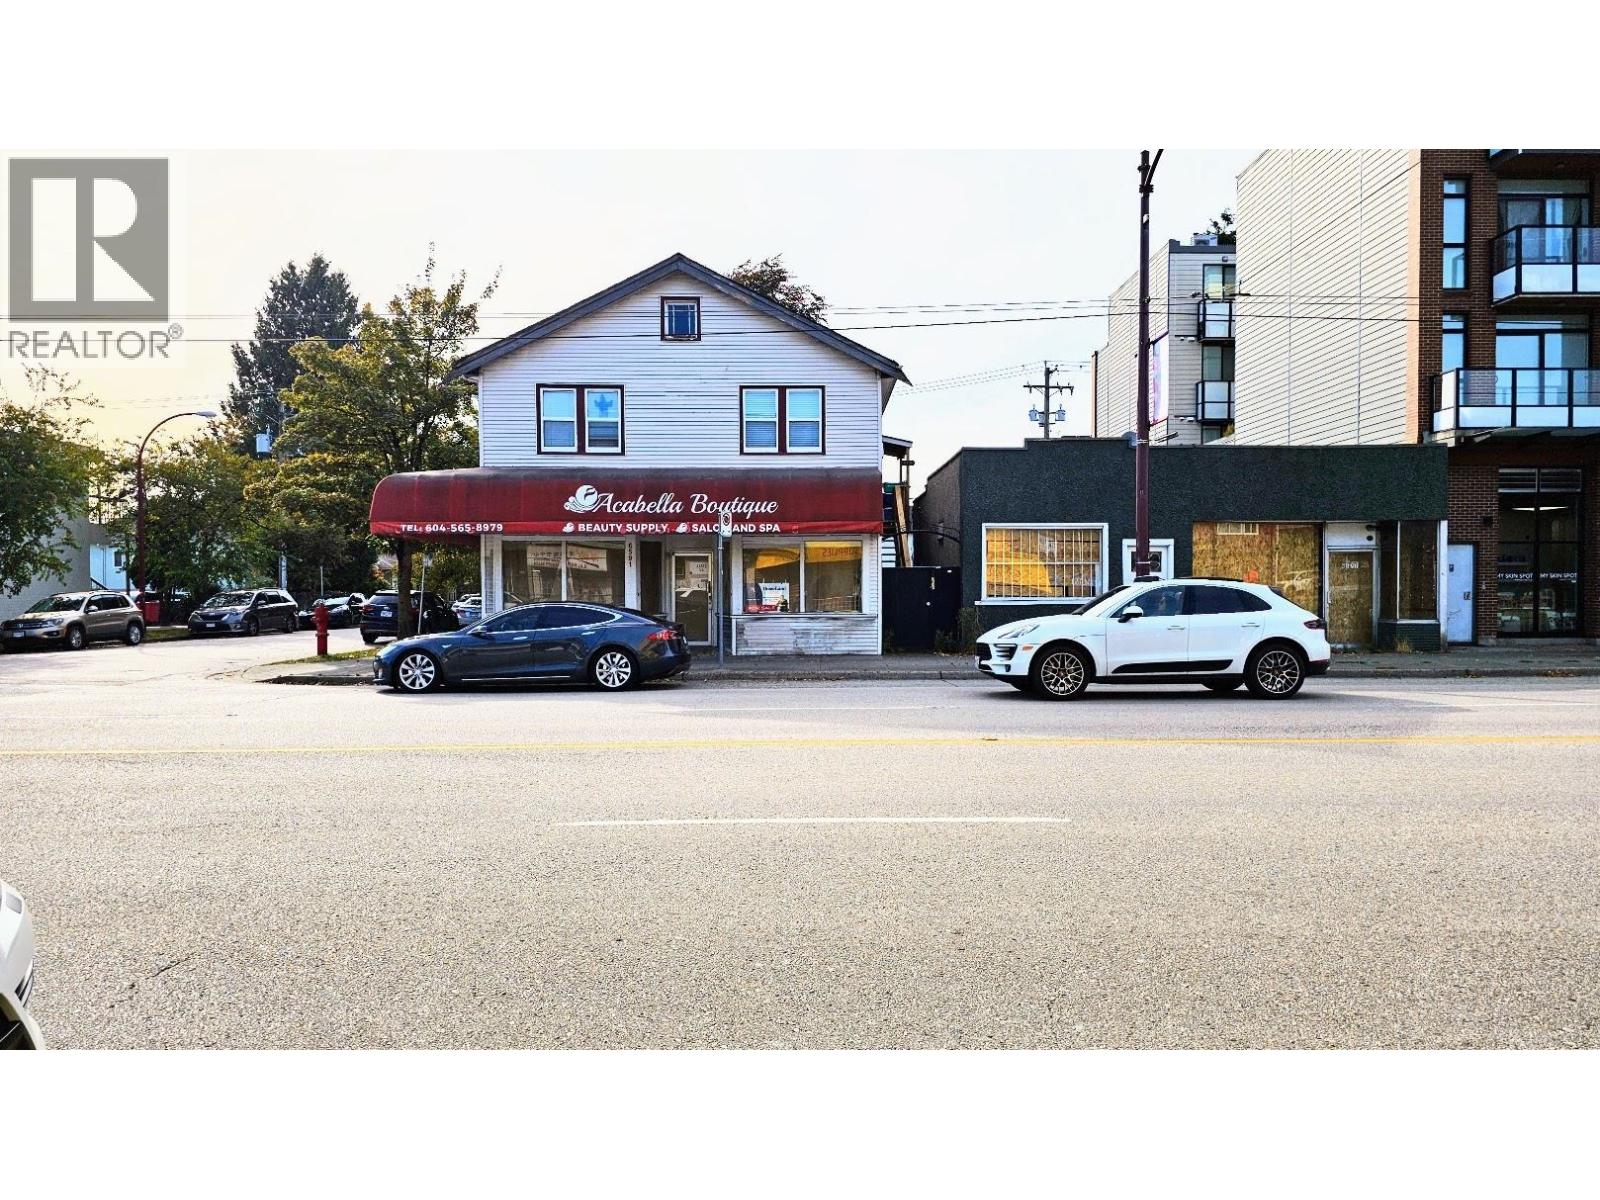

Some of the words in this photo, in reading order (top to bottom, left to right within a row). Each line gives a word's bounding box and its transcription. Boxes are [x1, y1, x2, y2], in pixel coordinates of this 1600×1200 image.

[593, 492, 684, 513] Acabella
[690, 493, 778, 519] Boutique
[425, 523, 503, 533] 604-565-8979
[578, 523, 623, 533] BEAUTY
[625, 523, 668, 533] SUPPLY
[732, 523, 756, 533] AND
[758, 523, 780, 533] SPA
